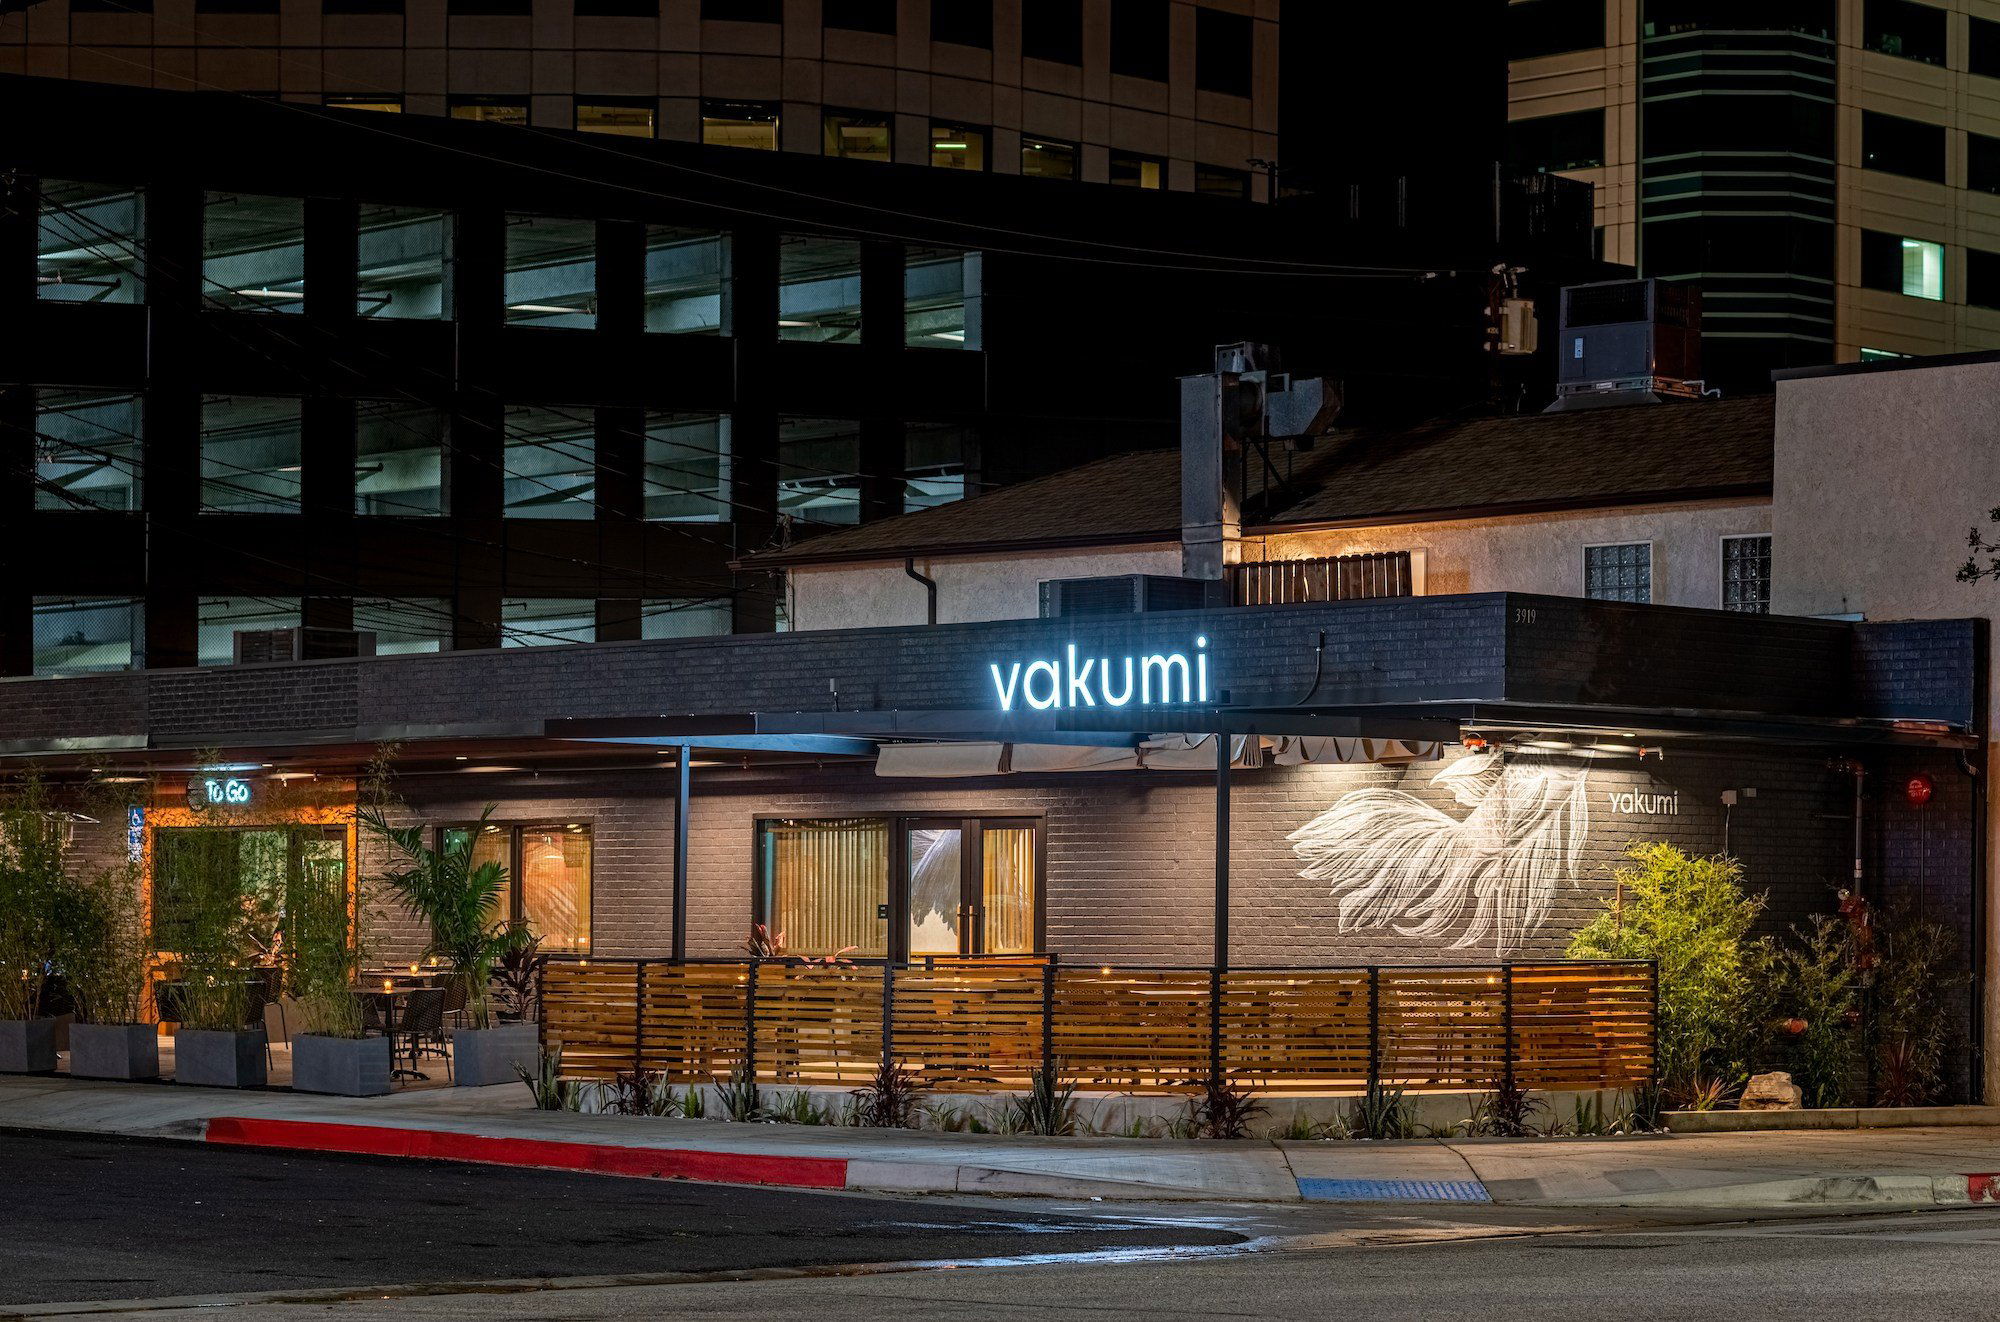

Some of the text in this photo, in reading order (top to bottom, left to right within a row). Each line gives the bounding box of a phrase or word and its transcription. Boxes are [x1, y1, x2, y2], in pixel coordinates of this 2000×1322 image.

[1515, 608, 1536, 624] 3919
[205, 780, 249, 802] To Go
[1608, 787, 1679, 816] yakumi
